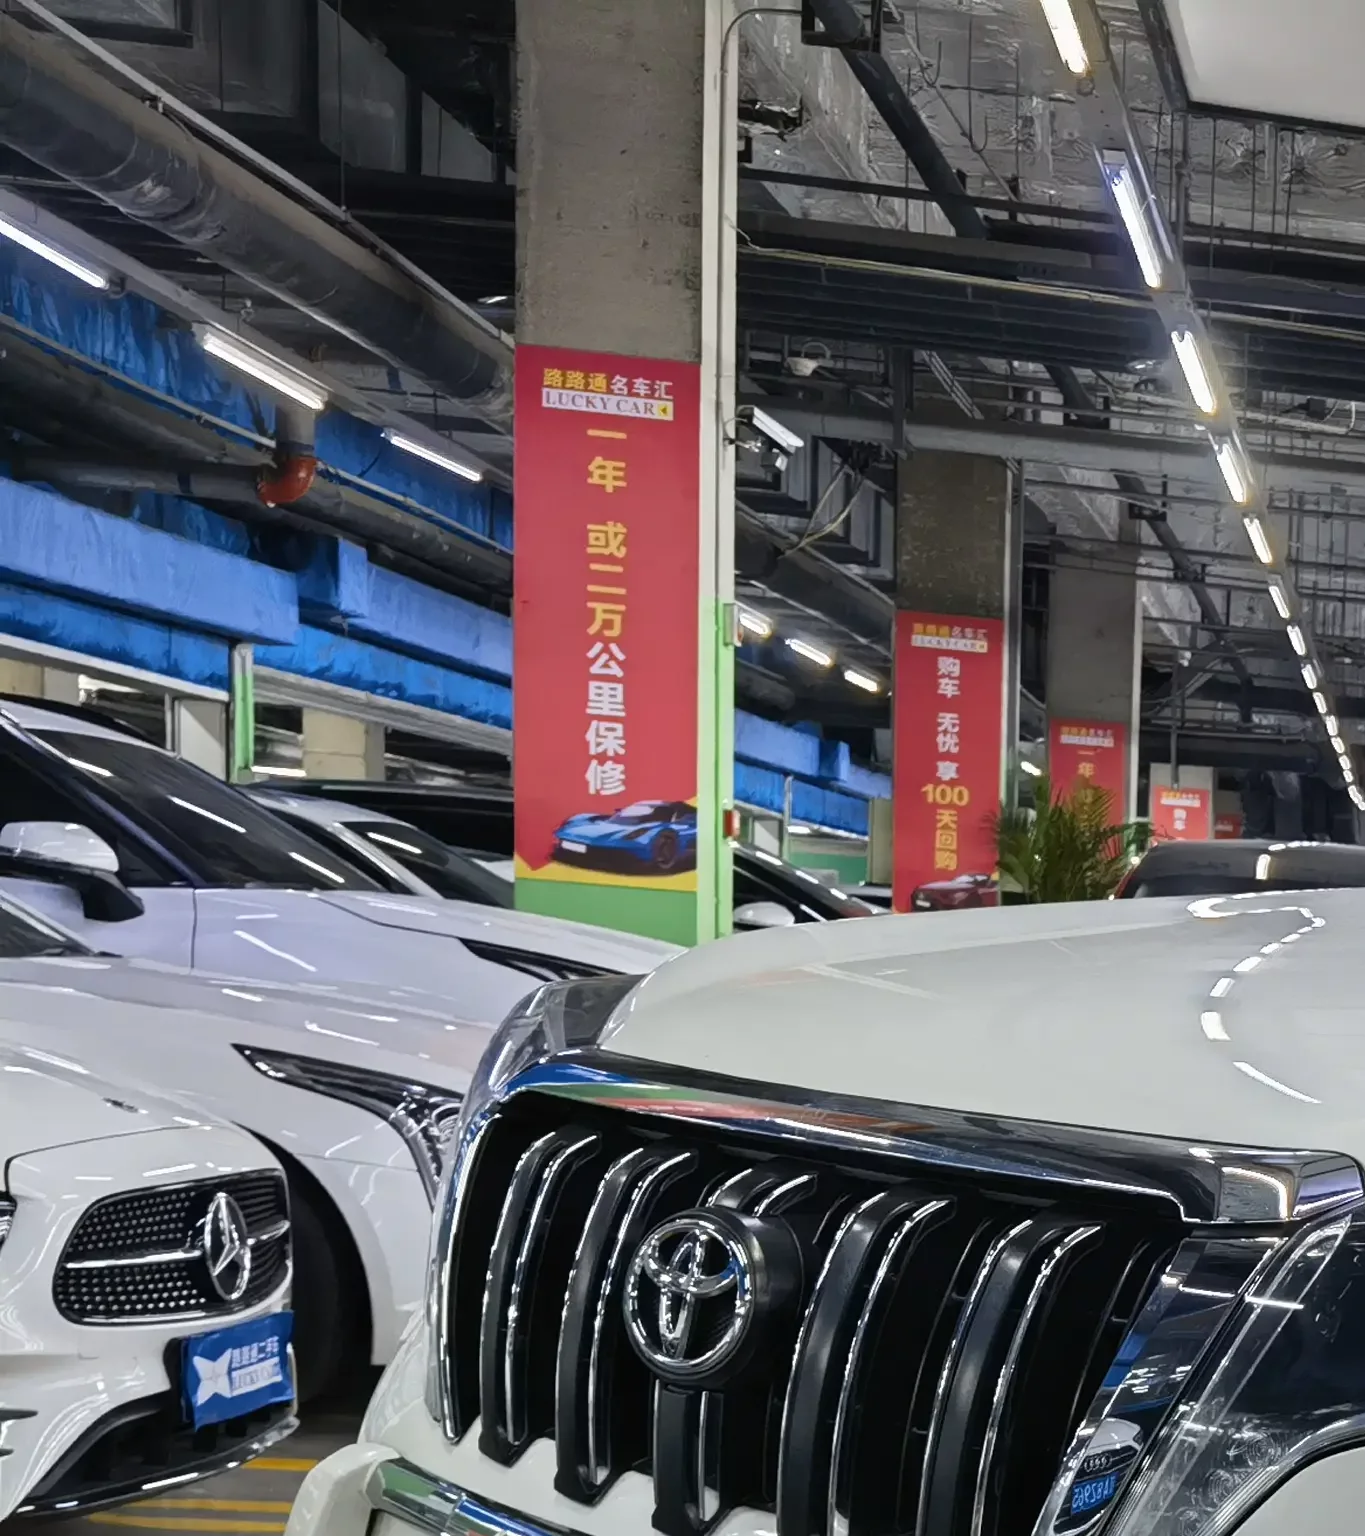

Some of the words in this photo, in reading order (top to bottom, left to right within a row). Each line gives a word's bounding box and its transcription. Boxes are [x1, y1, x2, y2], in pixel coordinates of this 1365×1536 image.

[543, 367, 674, 400] 路路通名车汇
[545, 390, 611, 411] LUCKY
[615, 398, 656, 416] CAR
